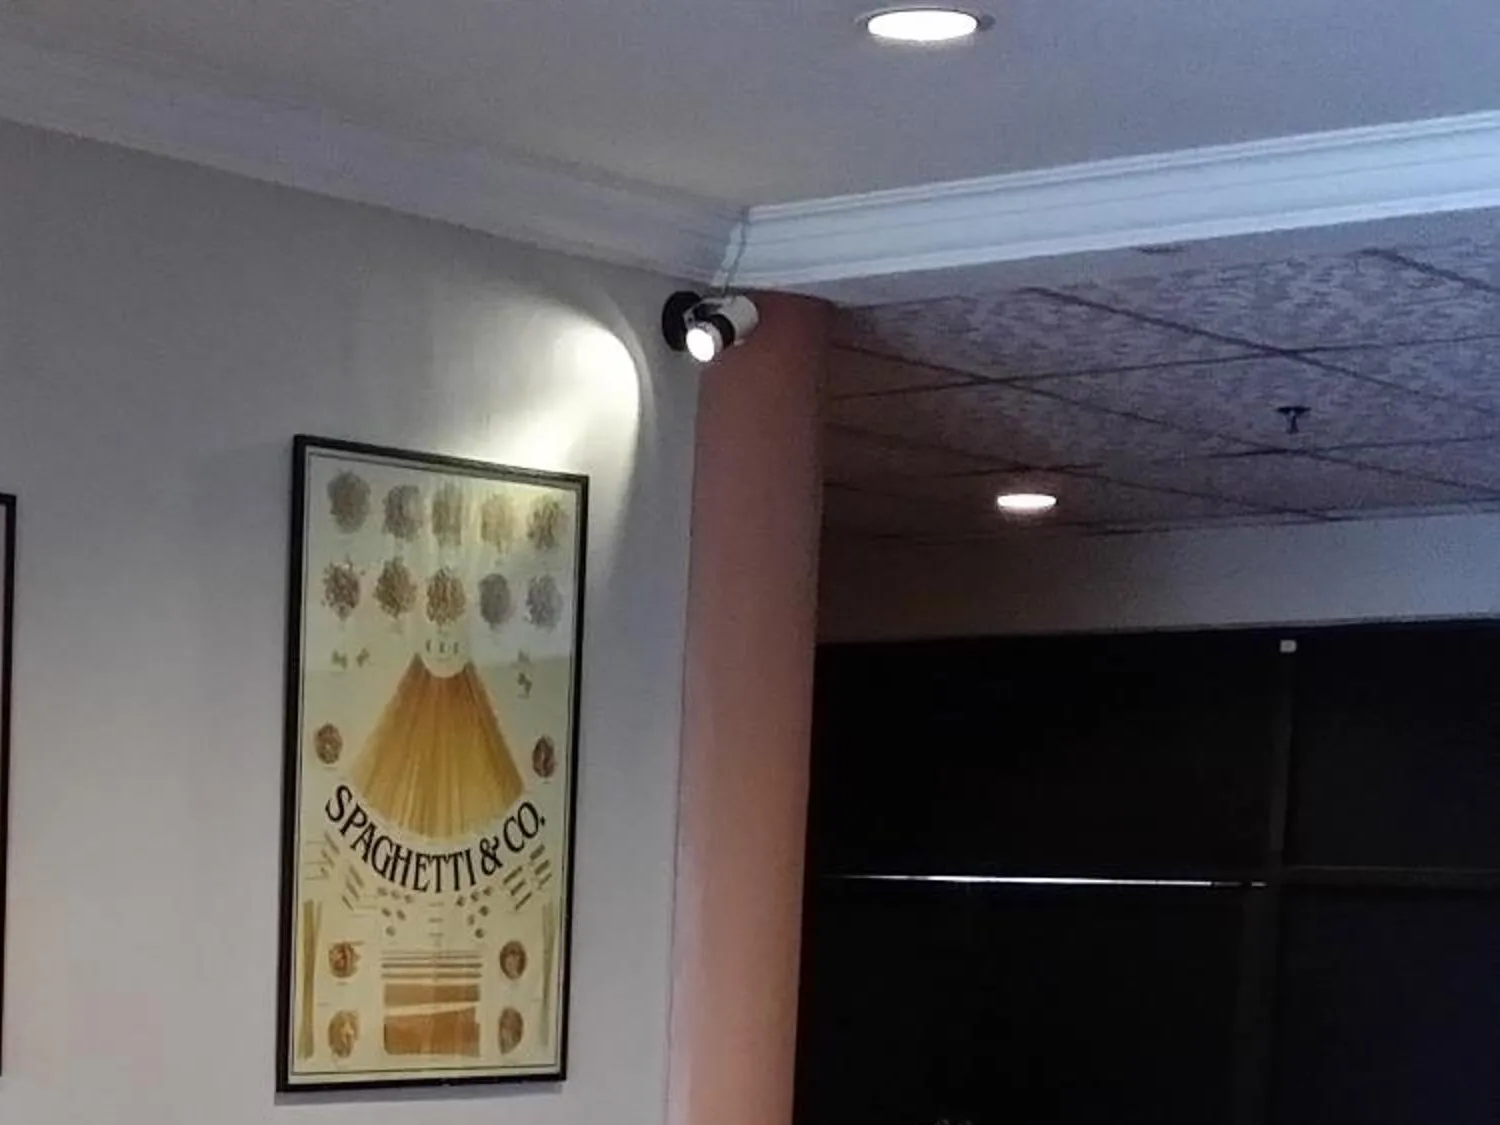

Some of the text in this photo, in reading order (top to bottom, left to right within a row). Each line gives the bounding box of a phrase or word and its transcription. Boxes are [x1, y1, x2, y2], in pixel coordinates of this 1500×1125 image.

[325, 784, 546, 893] SPAGHETTI & CO.
